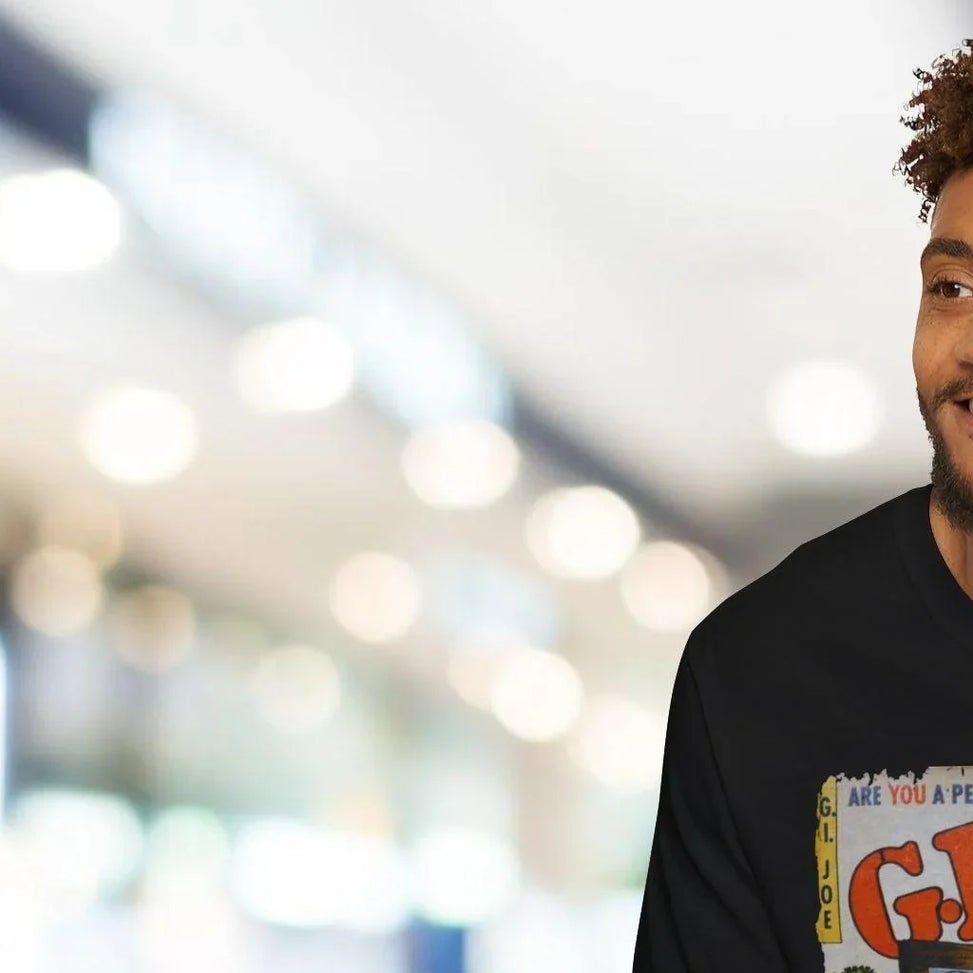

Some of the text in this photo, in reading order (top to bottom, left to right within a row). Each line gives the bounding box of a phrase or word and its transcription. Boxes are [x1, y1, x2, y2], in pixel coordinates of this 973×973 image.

[849, 785, 881, 807] ARE
[889, 784, 926, 804] YOU
[932, 784, 945, 804] A
